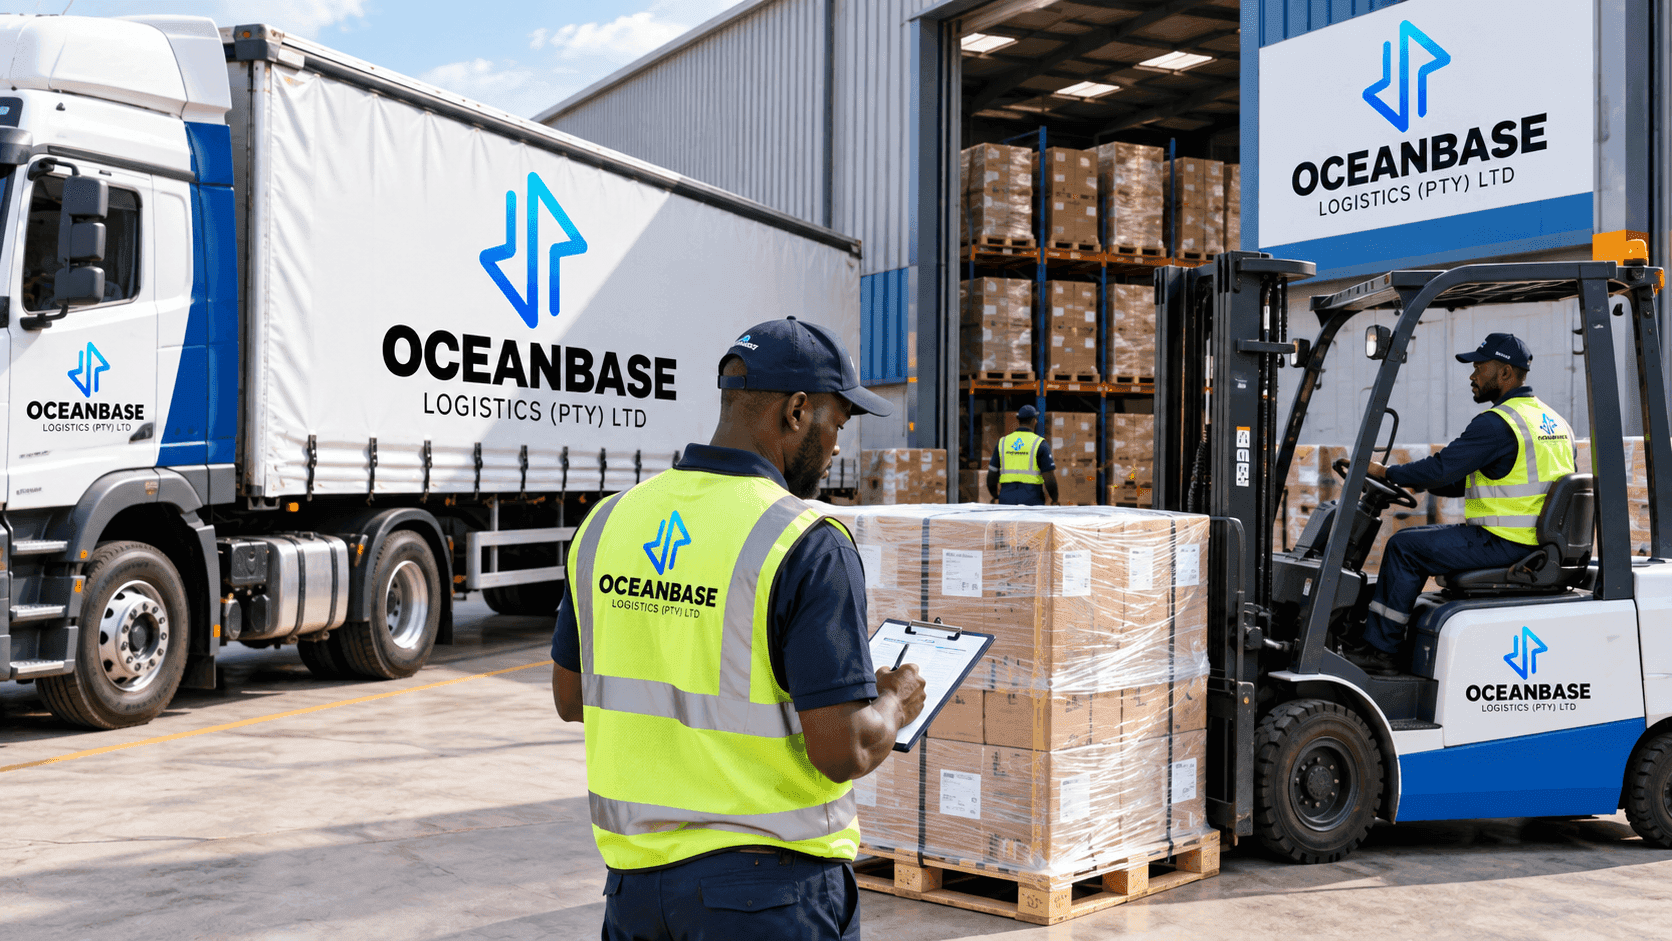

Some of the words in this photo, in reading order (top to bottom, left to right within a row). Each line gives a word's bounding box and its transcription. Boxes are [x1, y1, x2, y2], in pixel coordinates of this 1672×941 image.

[1292, 113, 1548, 197] OCEANBASE
[1319, 186, 1411, 217] LOGISTICS
[1418, 175, 1470, 200] (PTY)
[1480, 167, 1515, 188] LTD
[382, 325, 677, 400] OCEANBASE
[27, 401, 144, 420] OCEANBASE
[424, 393, 542, 422] LOGISTICS
[550, 402, 604, 429] (PTY)
[612, 408, 647, 429] LTD
[43, 423, 90, 432] LOGISTICS
[92, 423, 114, 432] (PTY)
[116, 423, 132, 432] LTD
[598, 574, 719, 608] OCEANBASE
[612, 599, 659, 614] LOGISTICS
[661, 605, 683, 618] (PTY)
[685, 608, 700, 619] LTD
[1466, 683, 1591, 702] OCEANBASE
[1482, 704, 1528, 713] LOGISTICS
[1532, 703, 1555, 713] (PTY)
[1560, 703, 1575, 711] LTD
